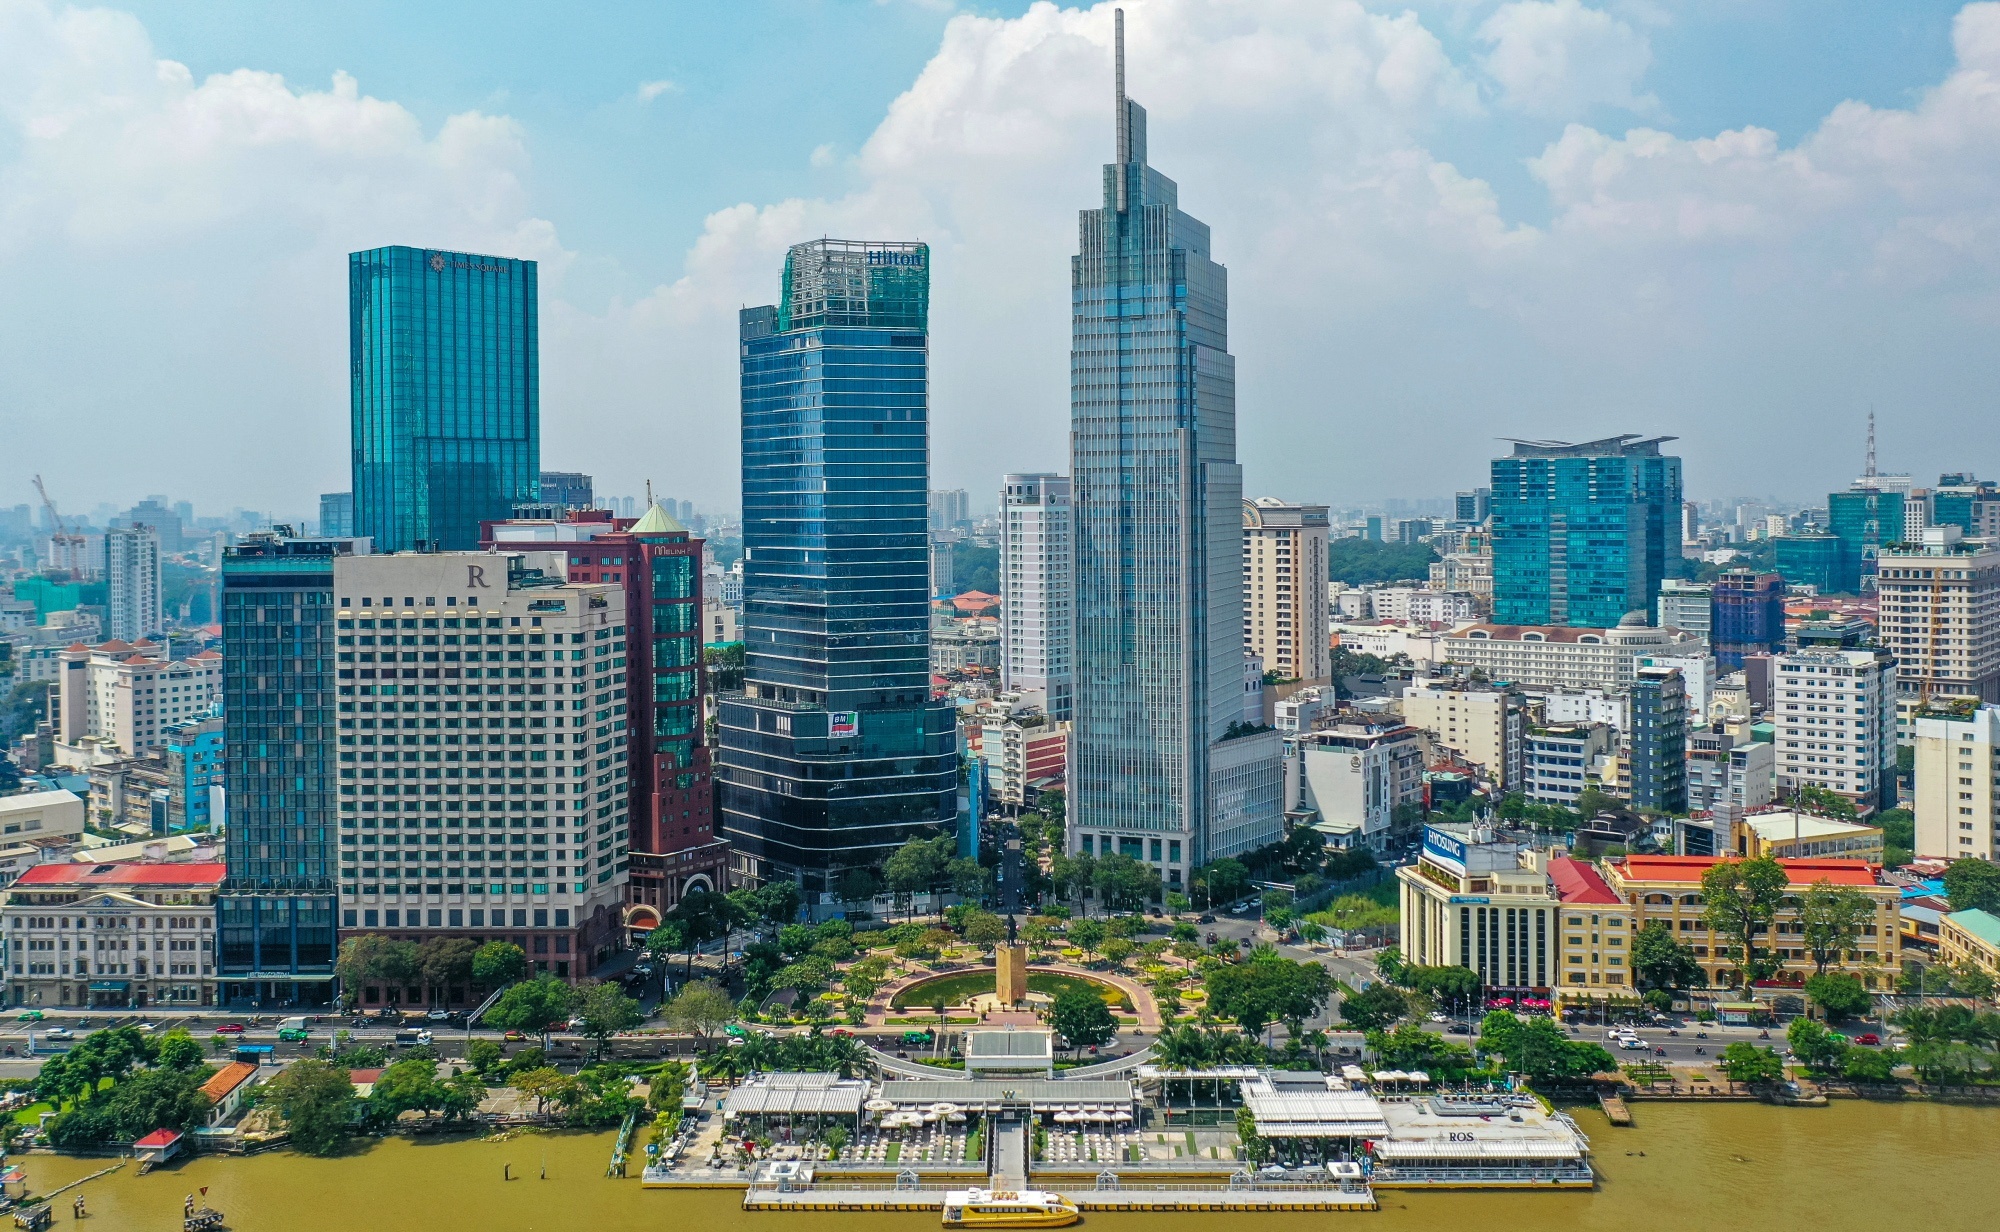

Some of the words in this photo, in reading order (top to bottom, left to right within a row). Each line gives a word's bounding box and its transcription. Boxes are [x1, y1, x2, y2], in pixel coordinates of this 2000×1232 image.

[868, 250, 923, 266] Hilton
[449, 260, 474, 270] TIMES
[476, 263, 509, 274] SQUARE
[467, 565, 491, 588] R
[834, 715, 846, 723] BM
[1428, 829, 1461, 857] HYOSUNG
[1449, 1132, 1474, 1142] ROS
